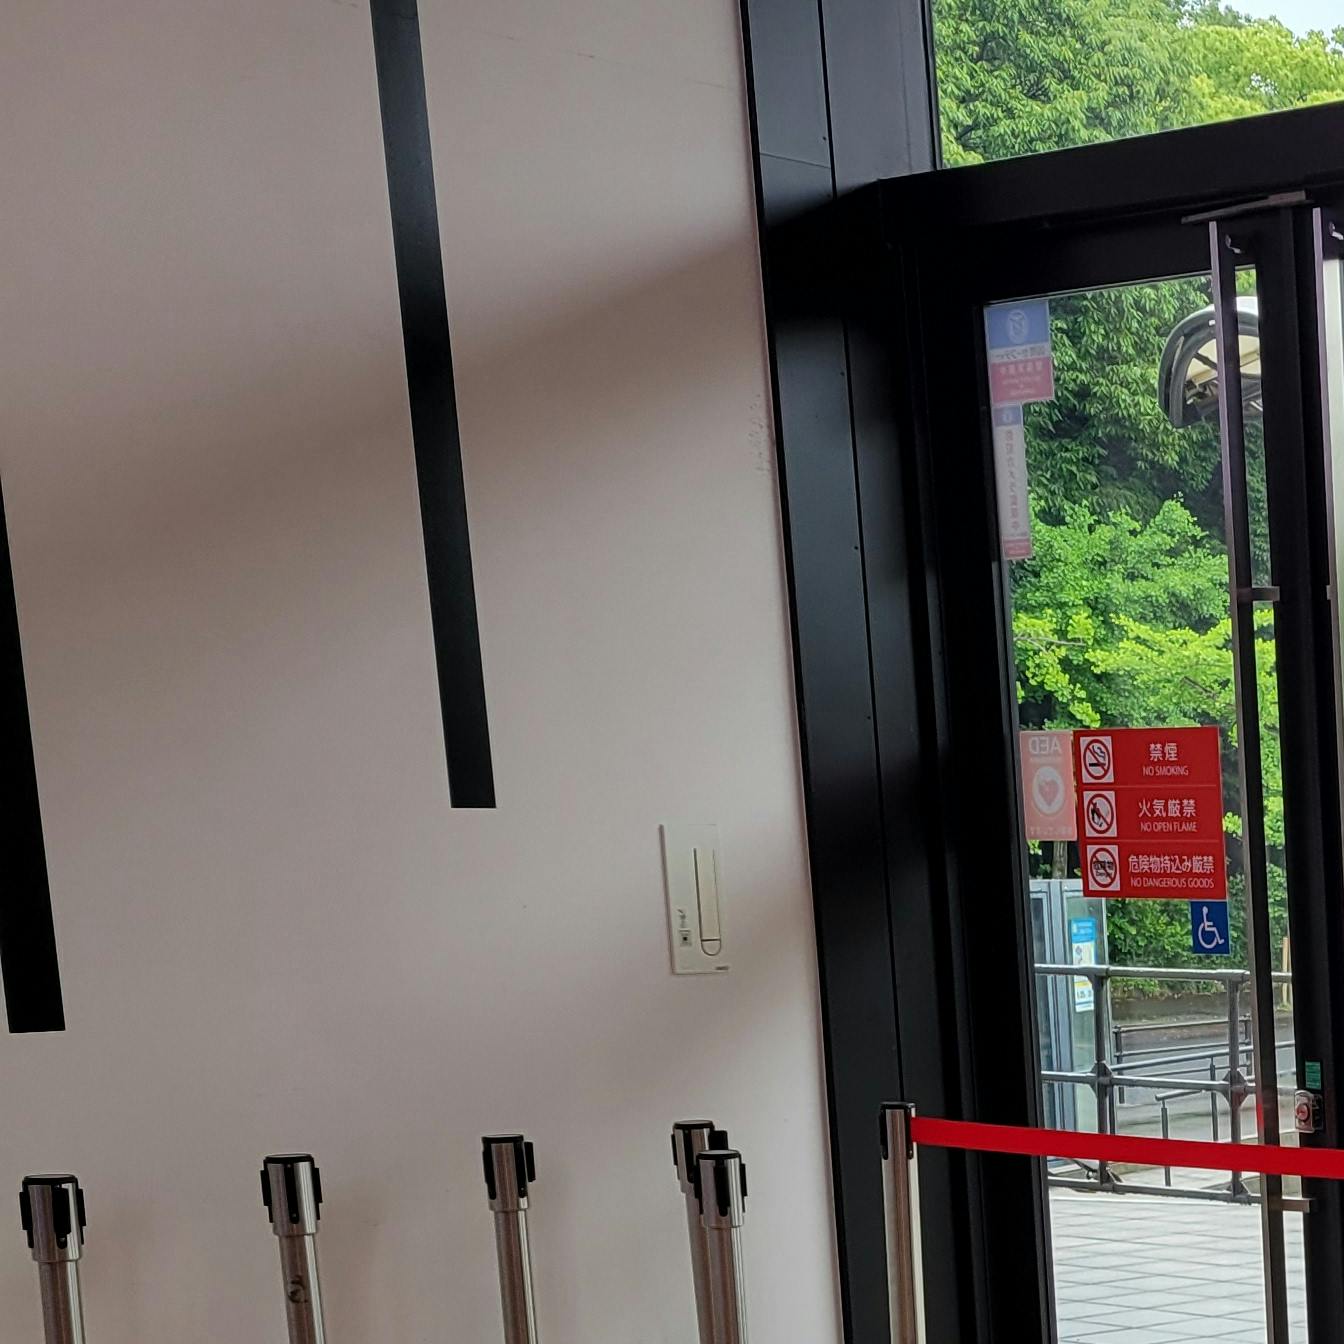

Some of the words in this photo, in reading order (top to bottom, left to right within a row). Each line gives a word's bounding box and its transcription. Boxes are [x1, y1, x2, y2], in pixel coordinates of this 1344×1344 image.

[1149, 743, 1178, 761] 禁煙
[1143, 766, 1154, 776] NO
[1155, 766, 1189, 776] SMOKING
[1138, 799, 1196, 818] 火気厳禁
[1141, 821, 1152, 832] NO
[1153, 821, 1172, 832] OPEN
[1173, 821, 1198, 832] FLAME
[1128, 855, 1214, 874] 危険物持込み厳禁
[1131, 877, 1142, 888] NO
[1143, 877, 1187, 888] DANGEROUS
[1188, 877, 1215, 889] GOODS
